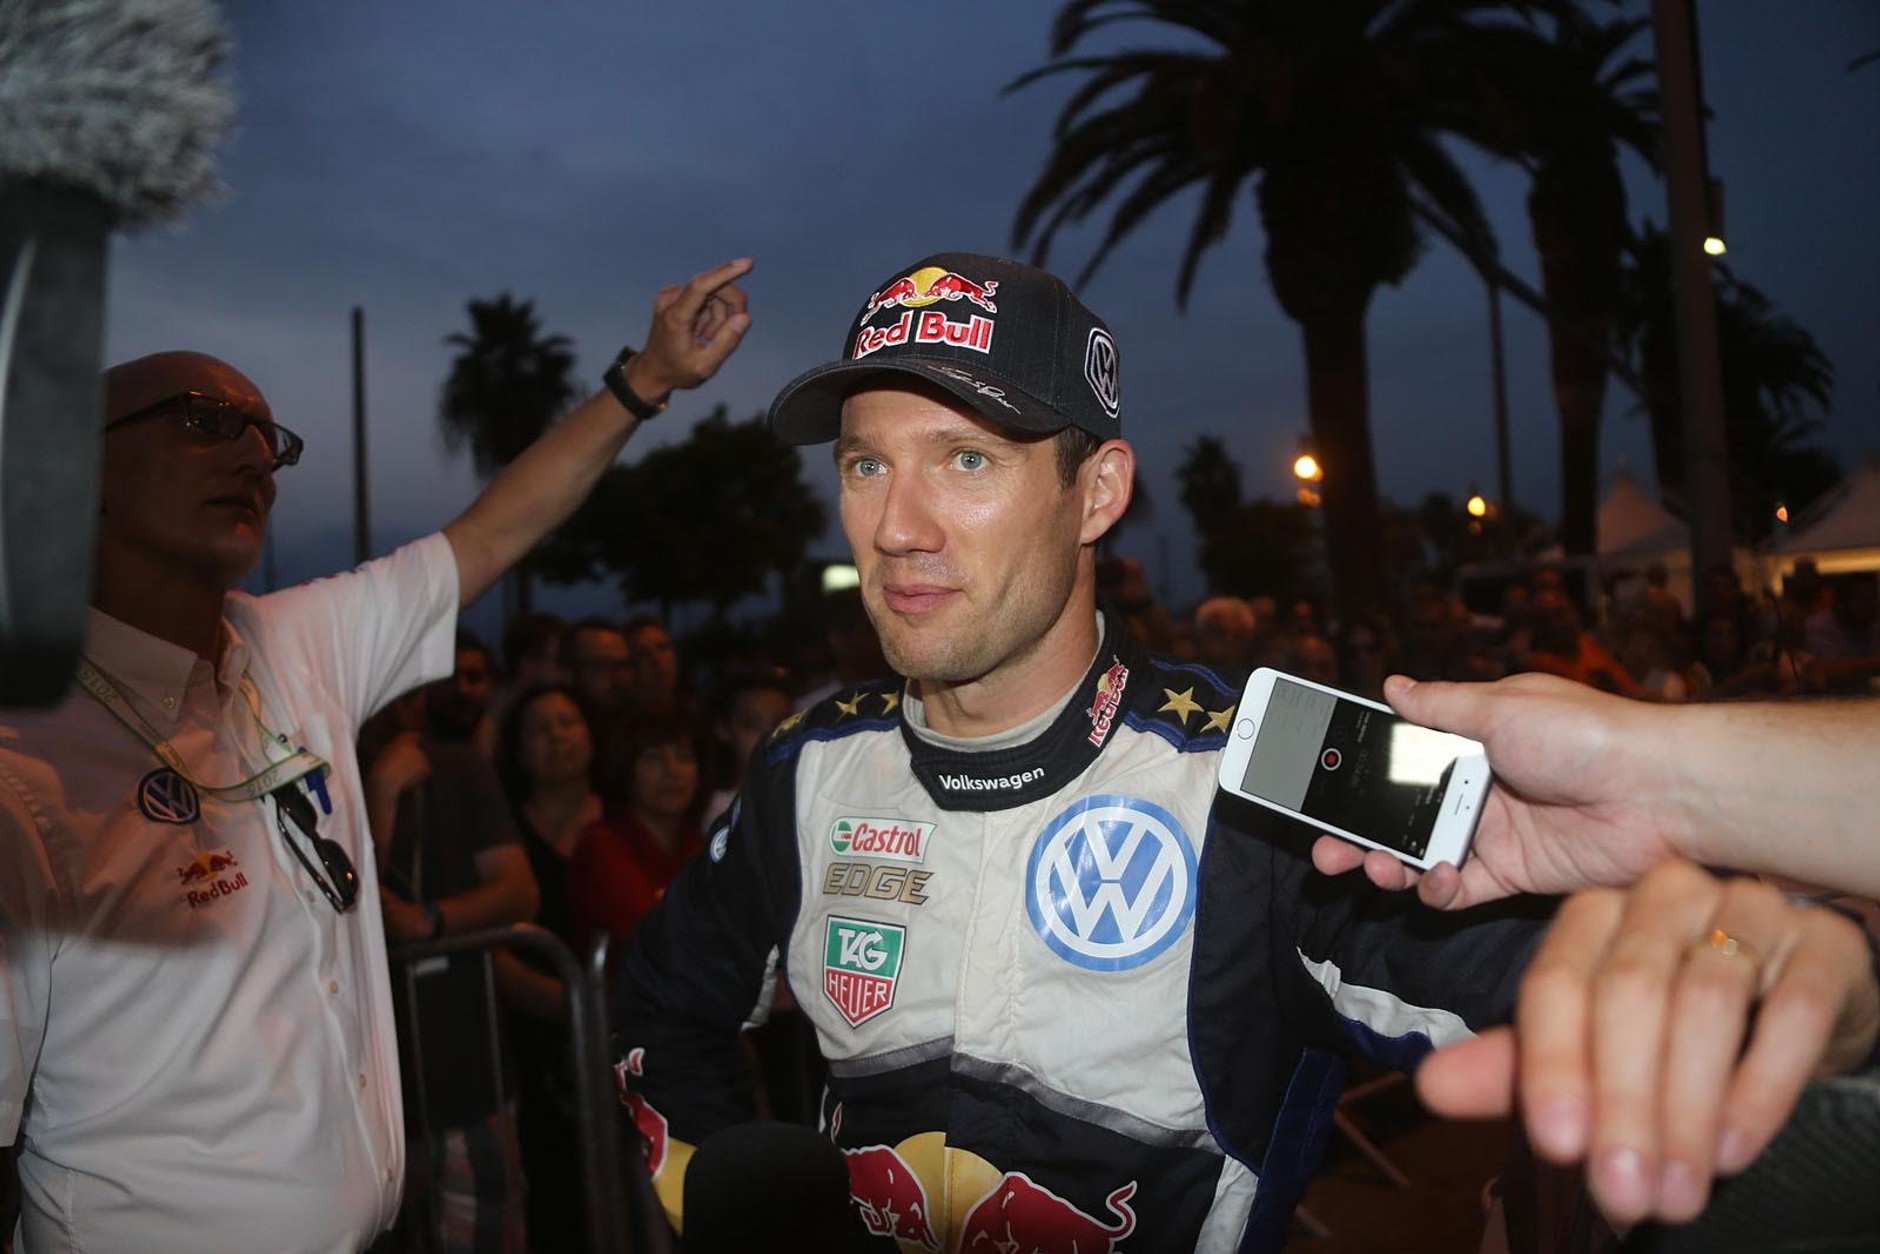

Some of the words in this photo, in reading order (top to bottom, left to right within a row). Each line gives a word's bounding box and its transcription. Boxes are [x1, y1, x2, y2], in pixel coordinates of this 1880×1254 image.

[853, 311, 913, 359] Red
[916, 311, 994, 354] Bull
[938, 767, 1045, 790] Volkswagen
[852, 822, 923, 857] Castrol
[823, 862, 935, 905] EDGE
[838, 928, 888, 971] TAG
[829, 972, 888, 1018] HEUER
